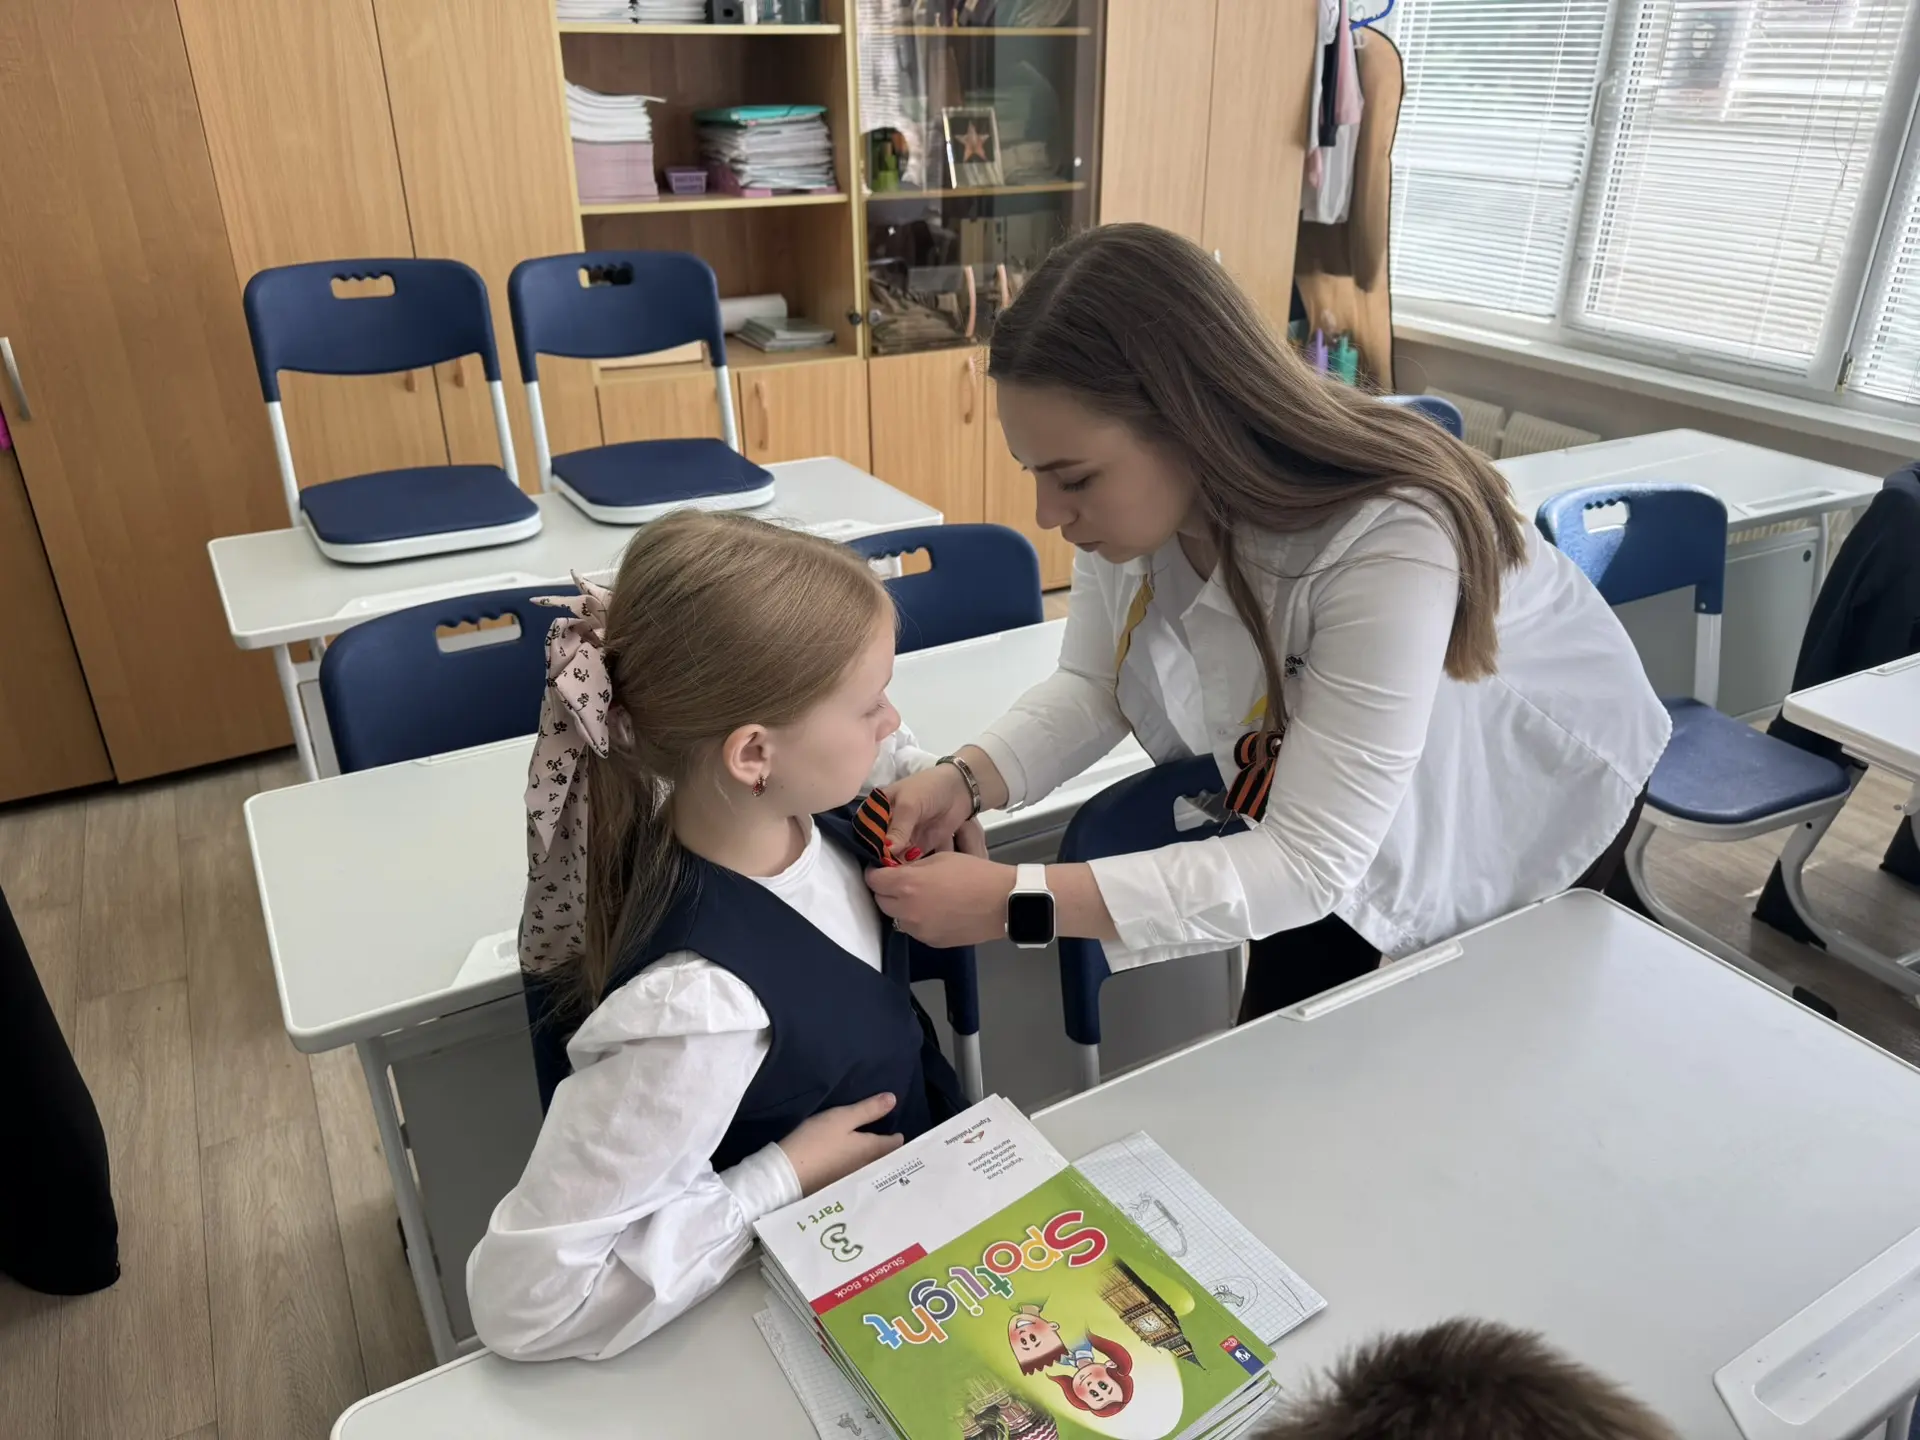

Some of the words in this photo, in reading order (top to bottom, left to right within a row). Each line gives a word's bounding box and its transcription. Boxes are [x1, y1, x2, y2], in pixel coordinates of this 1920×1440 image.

[971, 1117, 991, 1131] Express
[944, 1128, 972, 1145] Publishing
[993, 1138, 1011, 1151] Marina
[1001, 1152, 1016, 1163] Jenny
[1002, 1157, 1024, 1170] Virginia
[983, 1161, 1002, 1174] Dooley
[987, 1169, 1004, 1180] Evans
[808, 1201, 845, 1225] Part
[797, 1221, 807, 1232] 1
[820, 1222, 863, 1263] 3
[862, 1256, 905, 1283] Student's
[863, 1210, 1108, 1350] Spotlight
[835, 1281, 863, 1298] Book
